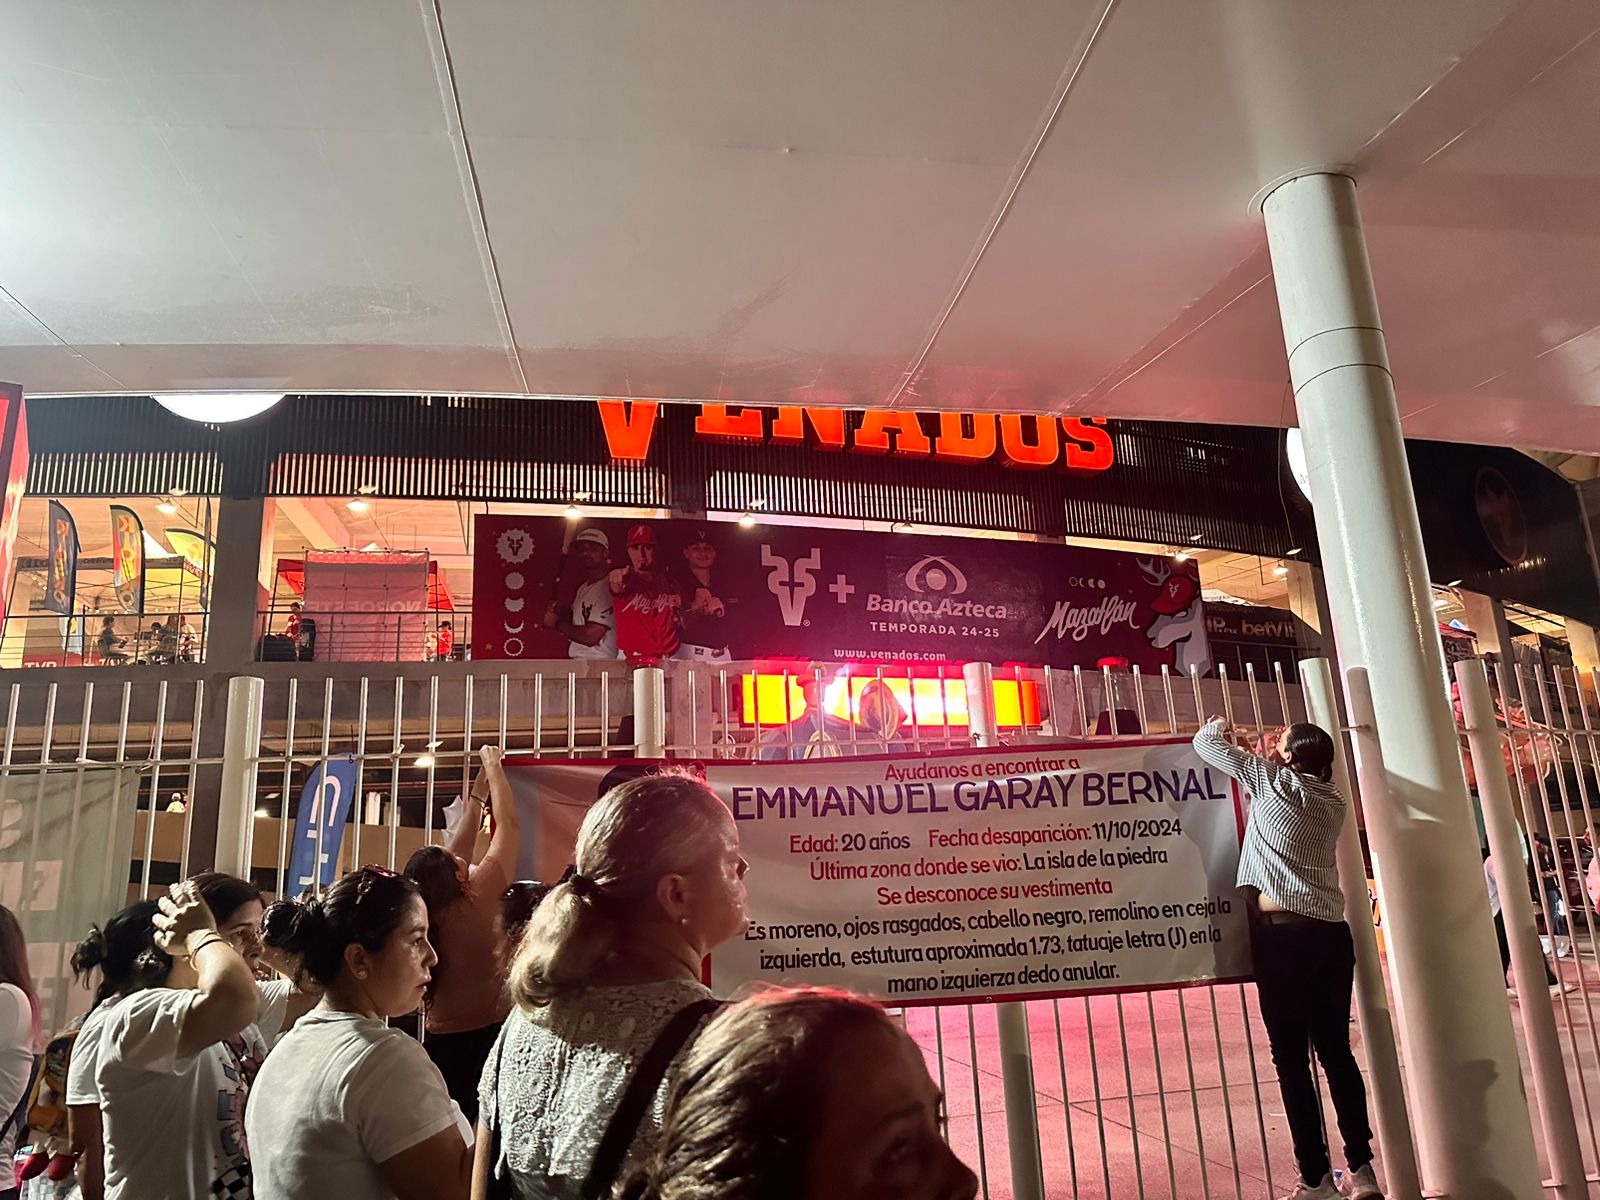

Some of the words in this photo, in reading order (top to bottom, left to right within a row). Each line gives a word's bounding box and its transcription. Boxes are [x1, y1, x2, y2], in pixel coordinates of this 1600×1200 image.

[866, 593, 932, 615] Banco
[936, 598, 1007, 620] Azteca
[870, 621, 957, 635] TEMPORADA
[961, 625, 1000, 638] 24-25
[833, 647, 946, 661] www.venados.com
[885, 763, 969, 782] Ayudanos
[973, 764, 983, 777] a
[985, 757, 1066, 776] encontrar
[1068, 758, 1080, 770] a
[732, 782, 949, 820] EMMANUEL
[953, 774, 1077, 812] GARAY
[1082, 767, 1227, 806] BERNAL
[790, 834, 839, 853] Edad:
[841, 833, 865, 851] 20
[869, 831, 911, 850] años
[929, 828, 979, 847] Fecha
[981, 823, 1092, 847] desaparición:
[1092, 818, 1182, 841] 11/10/2024
[810, 857, 868, 880] Última
[870, 864, 911, 878] zona
[914, 857, 968, 876] donde
[970, 857, 990, 873] se
[992, 853, 1021, 872] vio:
[1022, 852, 1045, 870] La
[1046, 850, 1075, 869] isla
[1077, 849, 1097, 867] de
[1099, 848, 1117, 866] la
[1117, 846, 1168, 868] piedra
[876, 886, 902, 905] Se
[904, 884, 998, 904] desconoce
[1000, 884, 1019, 899] su
[1020, 878, 1113, 898] vestimenta
[745, 921, 766, 940] Es
[769, 921, 841, 940] moreno,
[843, 916, 880, 939] ojos
[882, 912, 966, 936] rasgados,
[967, 908, 1030, 930] cabello
[1032, 910, 1086, 928] negro,
[1089, 901, 1159, 923] remolino
[1162, 902, 1184, 918] en
[1186, 897, 1216, 919] ceja
[1219, 896, 1231, 914] la
[760, 947, 846, 972] izquierda,
[851, 945, 923, 966] estutura
[926, 936, 1028, 963] aproximada
[1029, 936, 1065, 955] 1.73,
[1067, 931, 1123, 953] tatuaje
[1125, 930, 1165, 948] letra
[1167, 926, 1187, 949] (J)
[1189, 931, 1207, 944] en
[1208, 924, 1220, 943] la
[888, 976, 938, 993] mano
[941, 967, 1015, 992] izquierza
[1017, 964, 1060, 985] dedo
[1062, 961, 1120, 982] anular.
